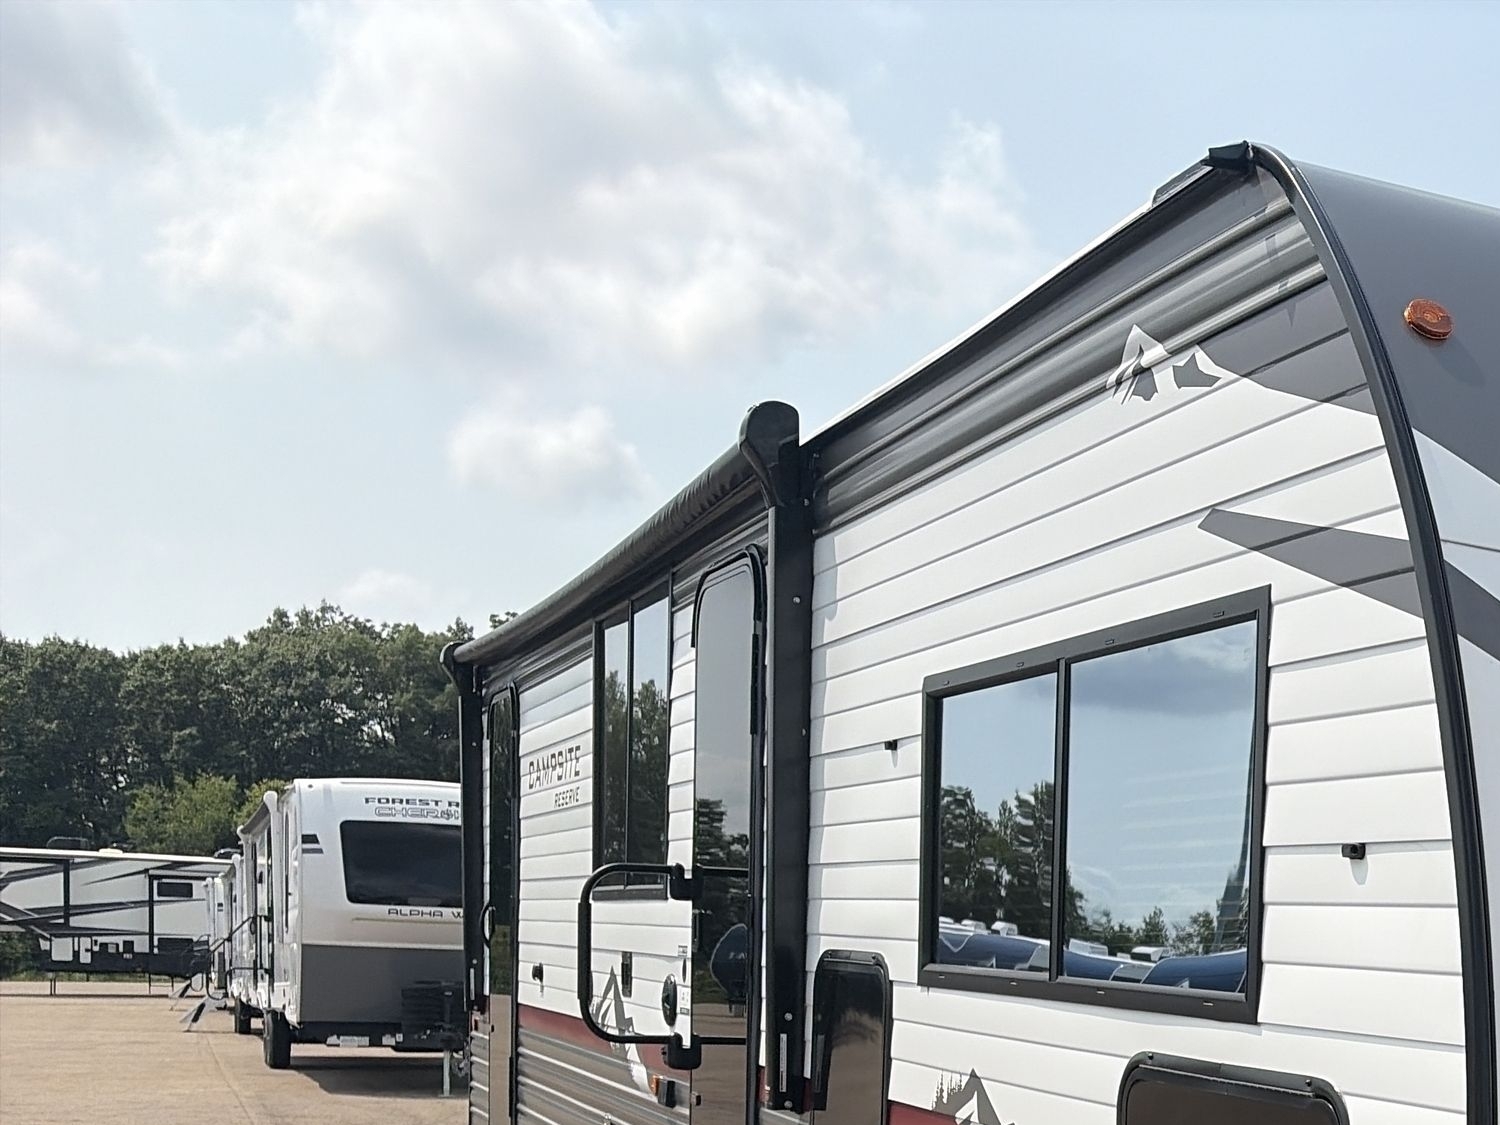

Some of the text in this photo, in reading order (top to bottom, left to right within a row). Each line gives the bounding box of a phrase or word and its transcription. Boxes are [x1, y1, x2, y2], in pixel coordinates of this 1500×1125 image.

[528, 745, 581, 790] CAMPSITE
[364, 797, 443, 806] FOREST
[554, 786, 580, 808] RESERVE
[388, 908, 443, 918] ALPHA
